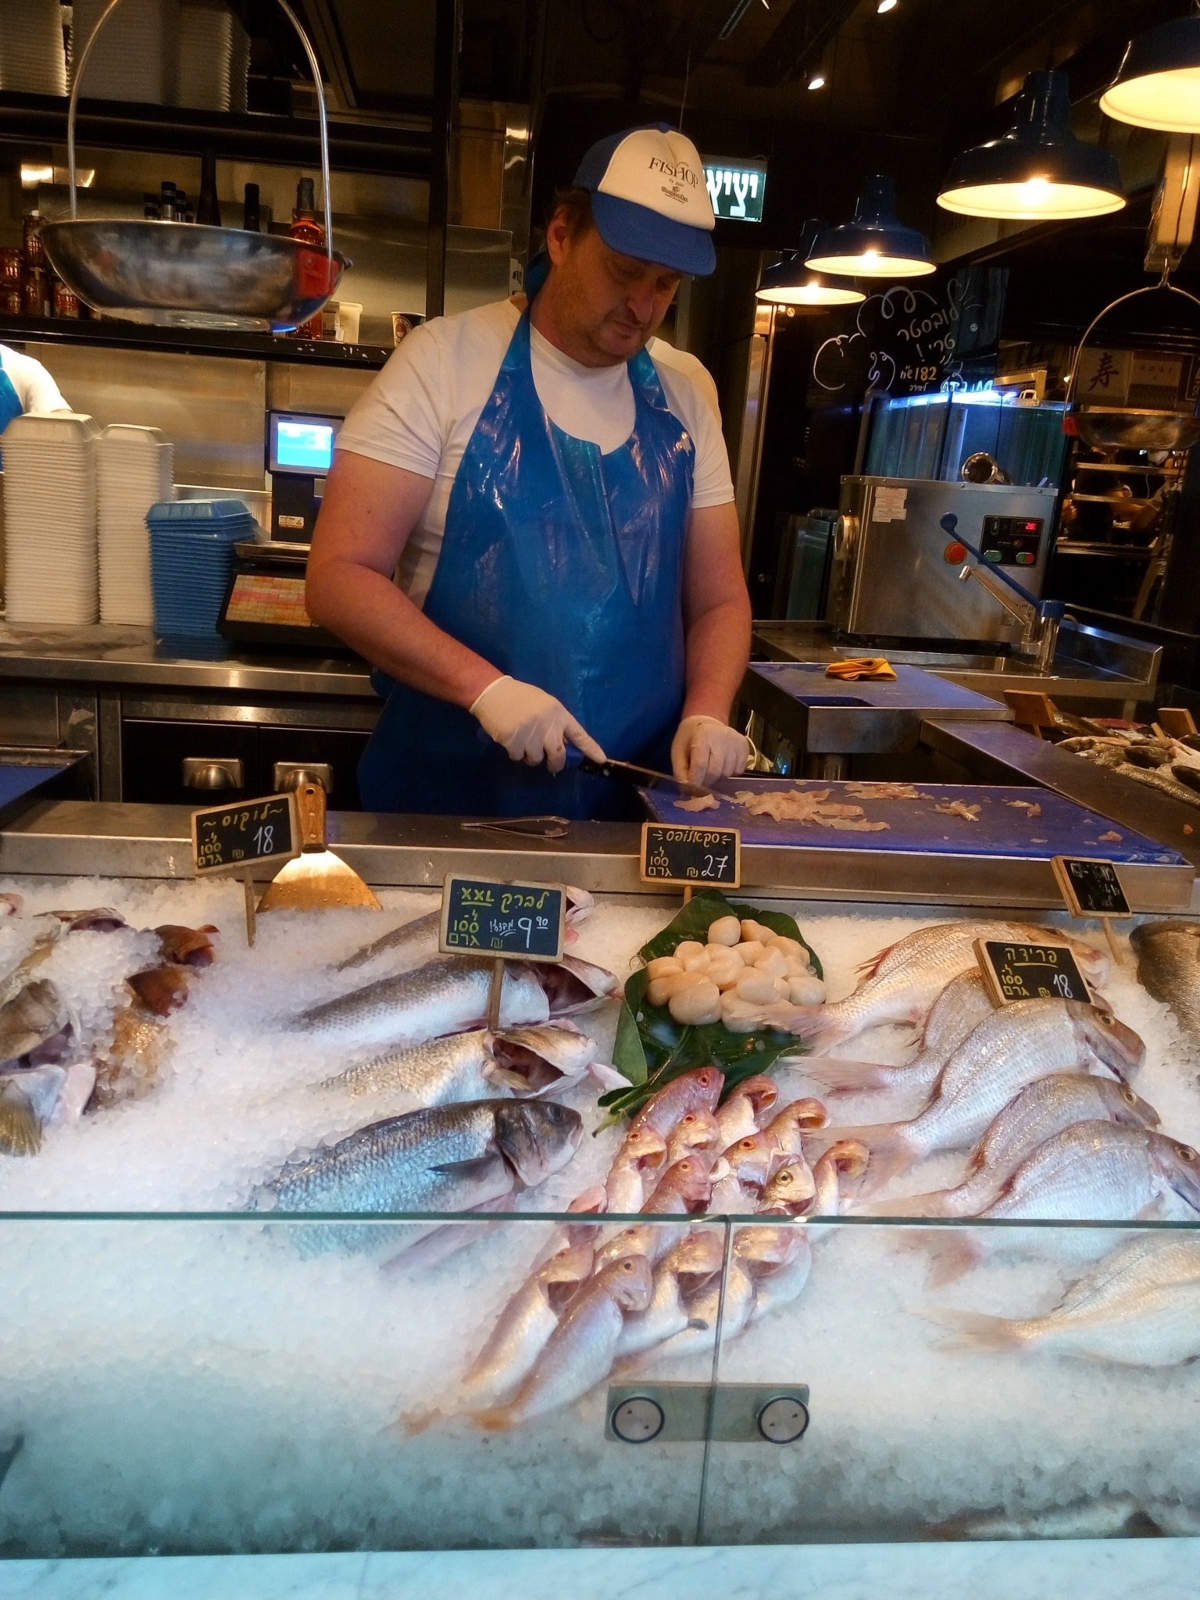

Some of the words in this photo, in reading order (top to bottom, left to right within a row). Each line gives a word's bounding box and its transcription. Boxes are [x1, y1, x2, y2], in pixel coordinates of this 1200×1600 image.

[702, 168, 759, 217] יציא
[897, 278, 962, 341] לובסטר
[914, 366, 937, 382] 182
[253, 825, 274, 854] 18
[200, 843, 222, 855] 100
[198, 854, 222, 866] גרם
[650, 856, 669, 867] 100
[701, 854, 729, 879] 27
[648, 867, 672, 877] גרם
[461, 887, 495, 902] XXL
[501, 891, 550, 913] לברק
[453, 920, 480, 933] 100
[449, 932, 480, 946] גרם
[1005, 948, 1058, 963] פרידה
[1001, 975, 1023, 985] 100
[1053, 974, 1074, 999] 18
[1003, 985, 1030, 996] גרם
